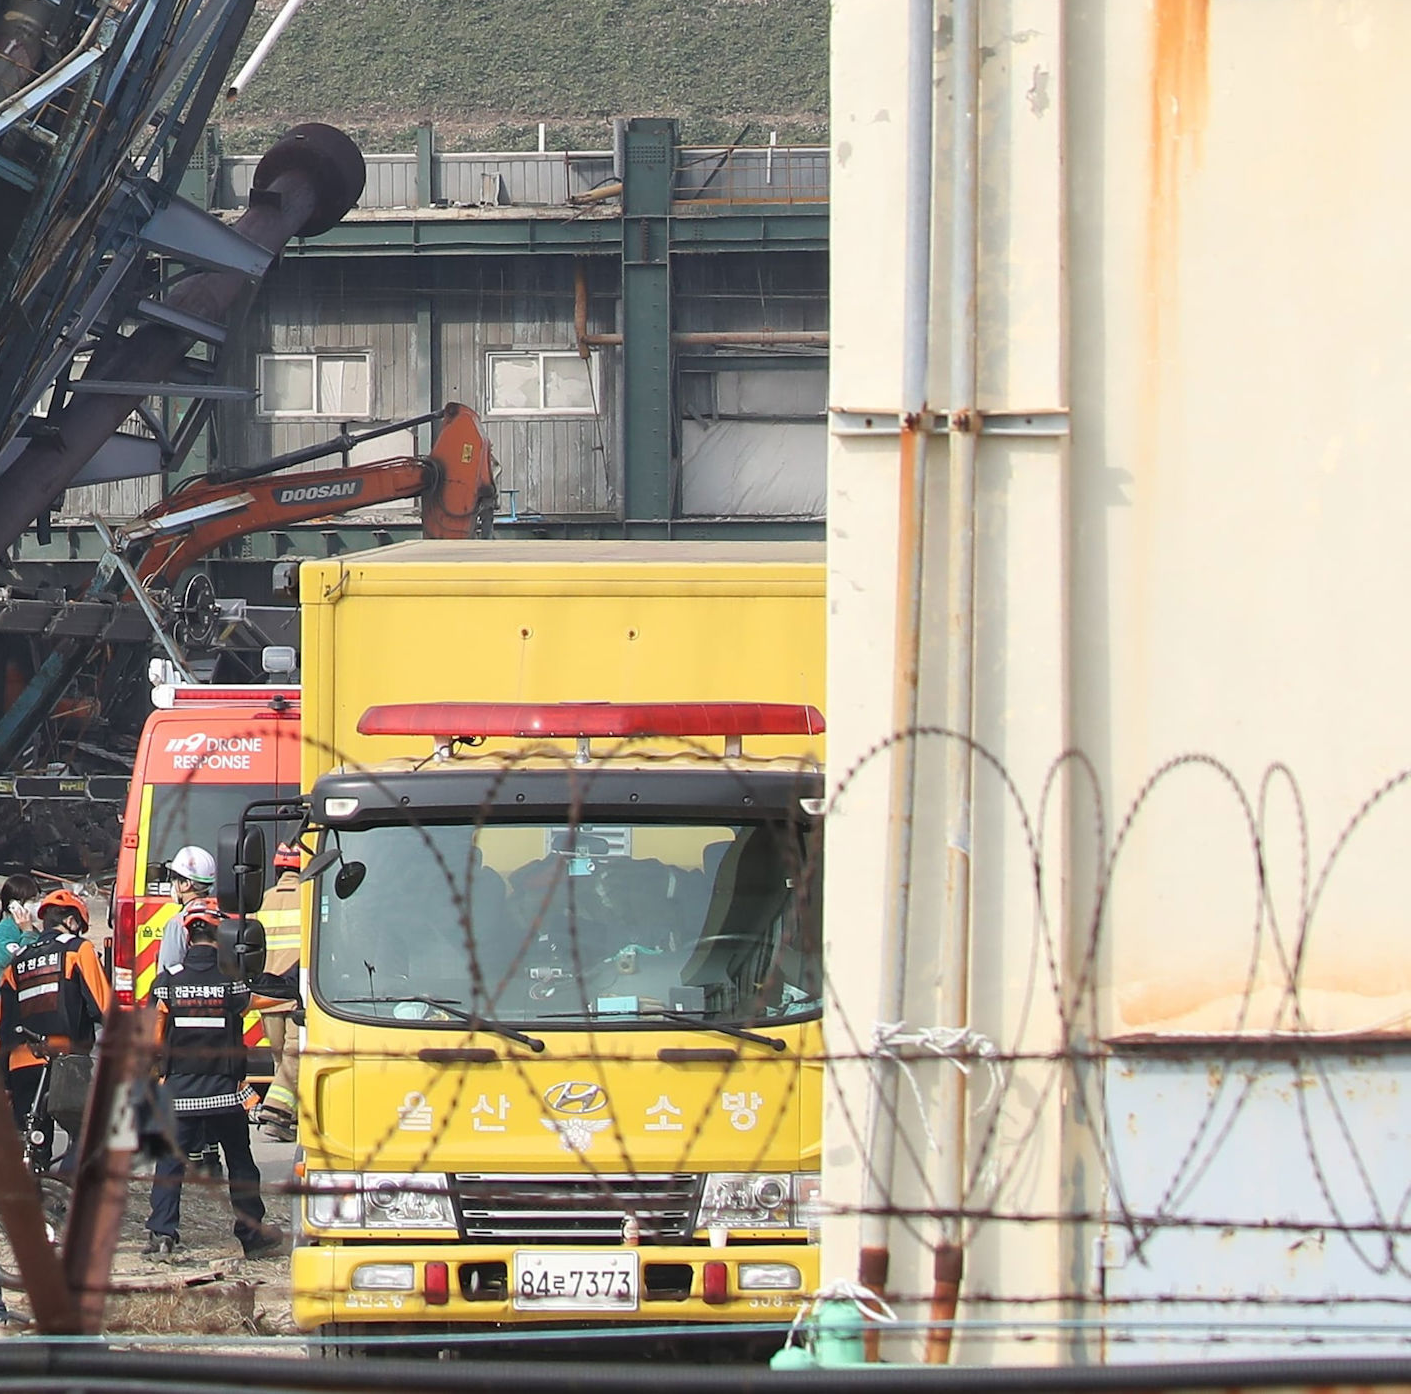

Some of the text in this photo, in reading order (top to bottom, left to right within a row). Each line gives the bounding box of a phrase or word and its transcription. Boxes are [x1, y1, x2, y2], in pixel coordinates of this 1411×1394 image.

[280, 482, 356, 503] DOOSAN
[164, 732, 263, 752] 119 DRONE
[172, 754, 251, 770] RESPONSE
[16, 952, 59, 975] 안전요원
[174, 985, 225, 999] 긴급구조통제단
